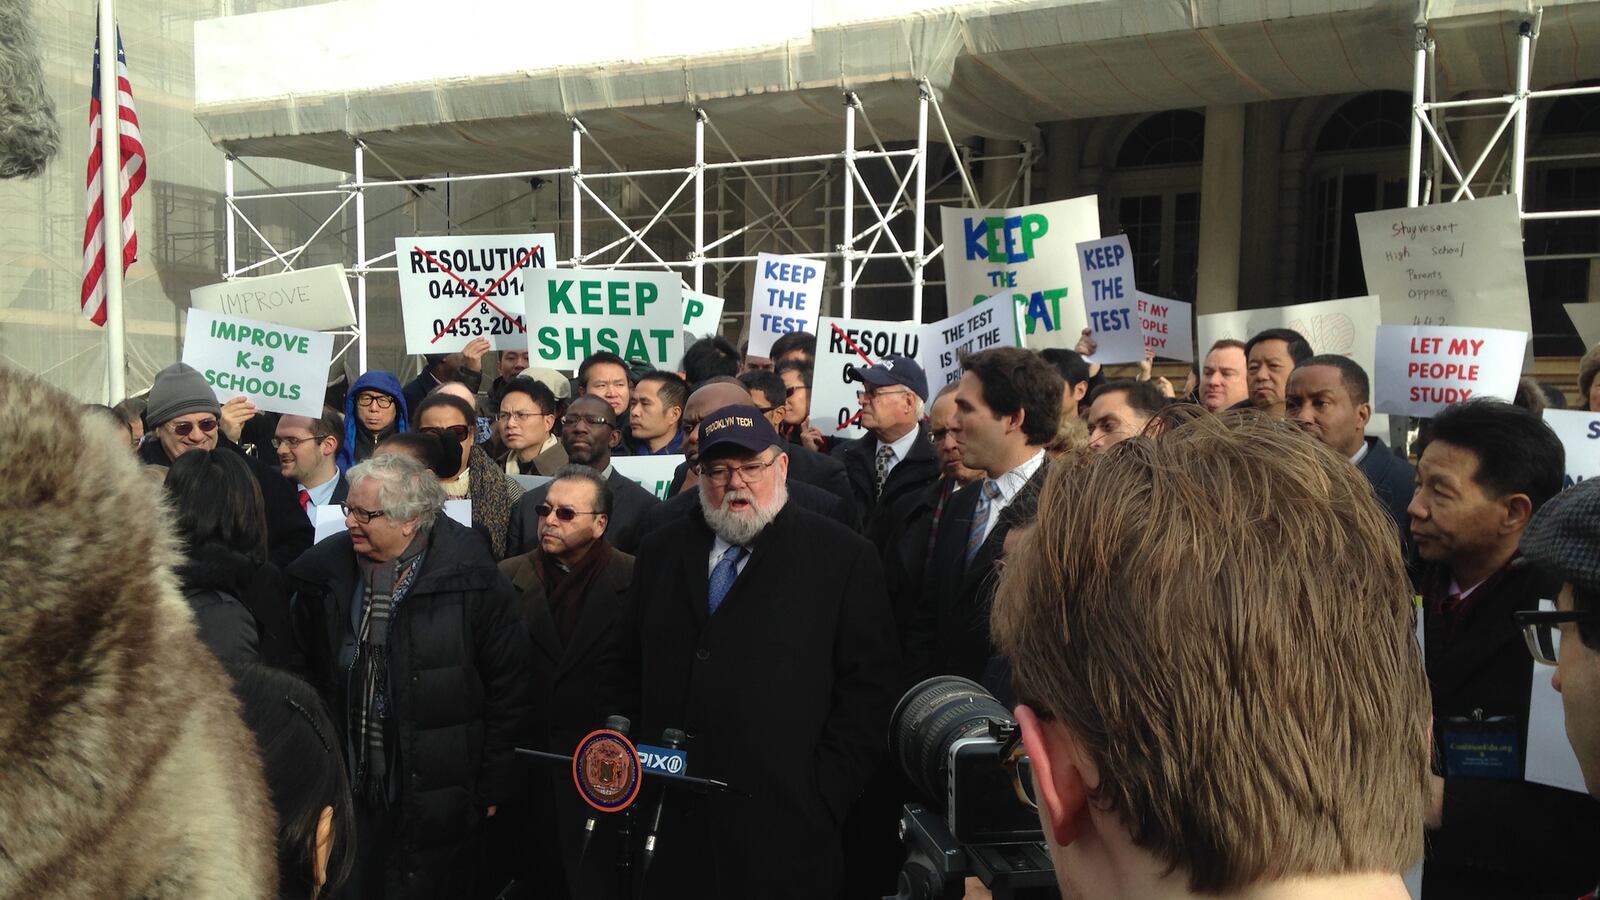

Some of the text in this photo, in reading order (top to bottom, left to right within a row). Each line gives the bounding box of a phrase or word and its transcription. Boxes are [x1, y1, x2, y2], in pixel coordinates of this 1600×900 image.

[963, 213, 1049, 265] KEEP
[1392, 220, 1458, 240] Stuyvesant
[410, 246, 546, 274] RESOLUTION
[1083, 244, 1125, 272] KEEP
[1385, 241, 1465, 262] High School
[764, 260, 817, 284] KEEP
[987, 271, 1017, 288] THE
[1406, 268, 1442, 281] Parents
[219, 285, 311, 315] IMPROVE
[547, 279, 658, 316] KEEP
[767, 288, 807, 311] THE
[1091, 276, 1124, 302] THE
[479, 302, 490, 315] &
[1150, 303, 1169, 318] MY
[433, 315, 527, 338] 0453-201
[760, 313, 808, 334] TEST
[942, 308, 994, 345] THE TEST
[1090, 308, 1131, 333] TEST
[211, 320, 309, 354] IMPROVE
[537, 327, 675, 363] SHSAT
[829, 327, 919, 359] RESOLU
[940, 351, 952, 368] IS
[977, 327, 1001, 350] THE
[1410, 337, 1484, 356] LET MY
[236, 350, 275, 373] K-8
[1408, 363, 1480, 381] PEOPLE
[205, 369, 301, 401] SCHOOLS
[1409, 386, 1472, 404] STUDY
[705, 416, 753, 436] BROOKLYN TECH
